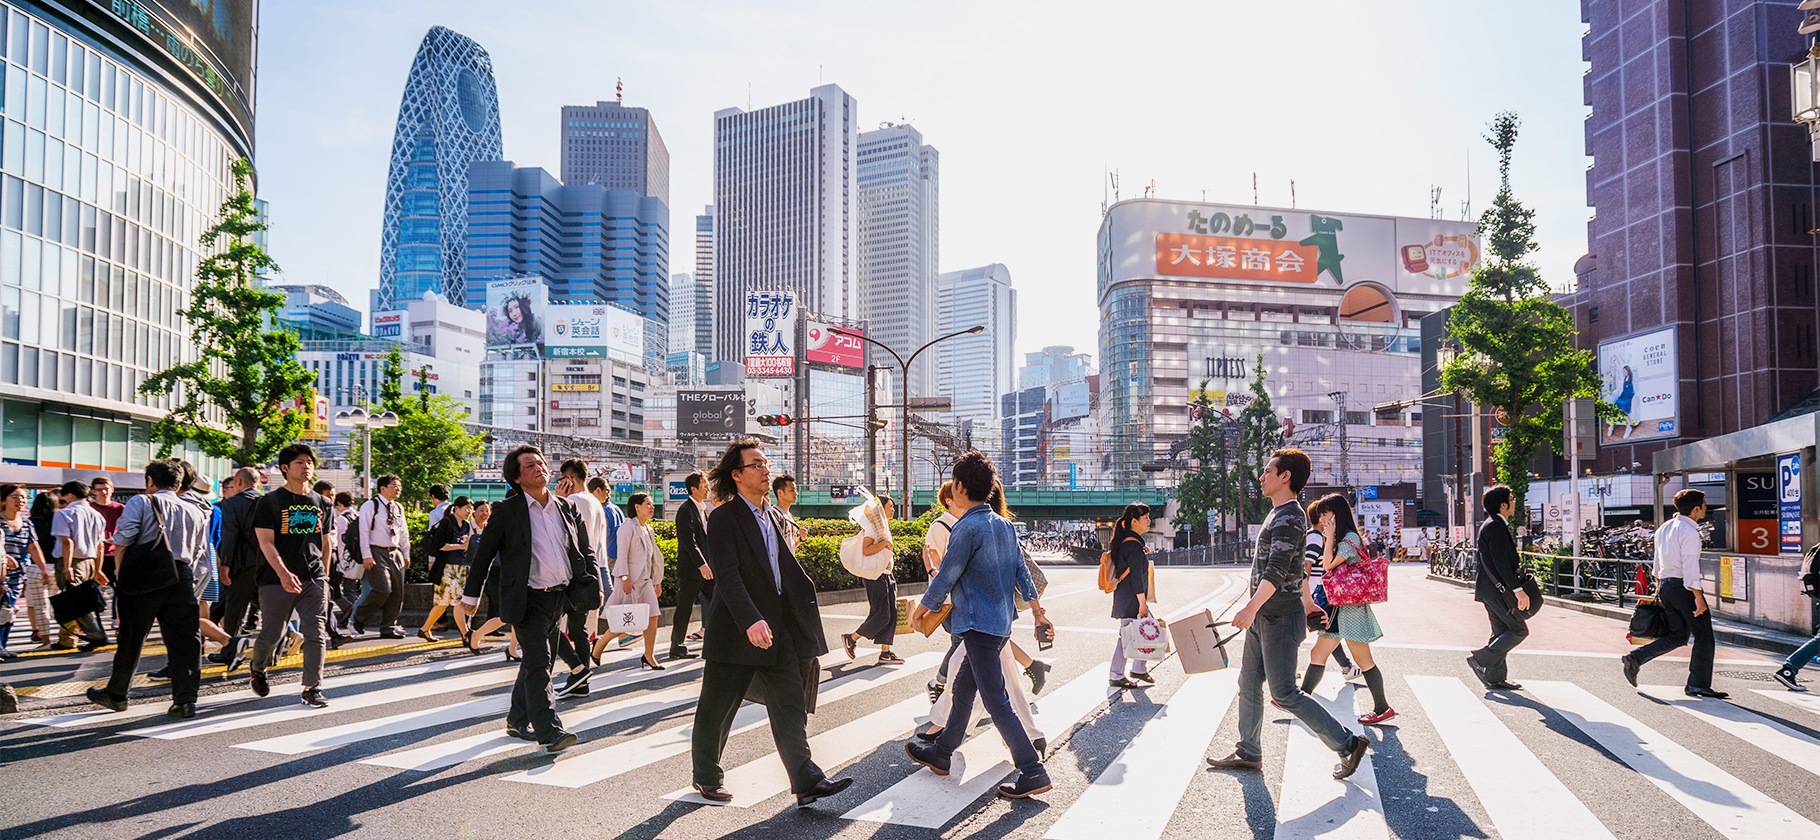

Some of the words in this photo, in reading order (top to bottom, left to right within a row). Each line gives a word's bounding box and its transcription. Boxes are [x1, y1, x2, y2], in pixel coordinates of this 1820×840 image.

[1188, 209, 1287, 239] たのめーる
[1170, 244, 1305, 273] 大塚商会
[1429, 249, 1466, 258] ITでオフィスを
[1430, 257, 1457, 265] 元気にする
[748, 292, 793, 318] カラオケ
[571, 318, 600, 326] シェーン
[765, 318, 775, 331] の
[571, 326, 600, 335] 英会話
[751, 331, 789, 354] 鉄人
[835, 335, 861, 349] アコム
[552, 347, 586, 356] 新宿本校
[1643, 350, 1667, 360] GENERAL
[831, 355, 841, 363] 2F
[1646, 358, 1663, 366] STORE
[747, 366, 793, 374] 03-3345-6430
[692, 410, 722, 425] global
[1781, 465, 1792, 499] P
[1751, 527, 1769, 549] 3
